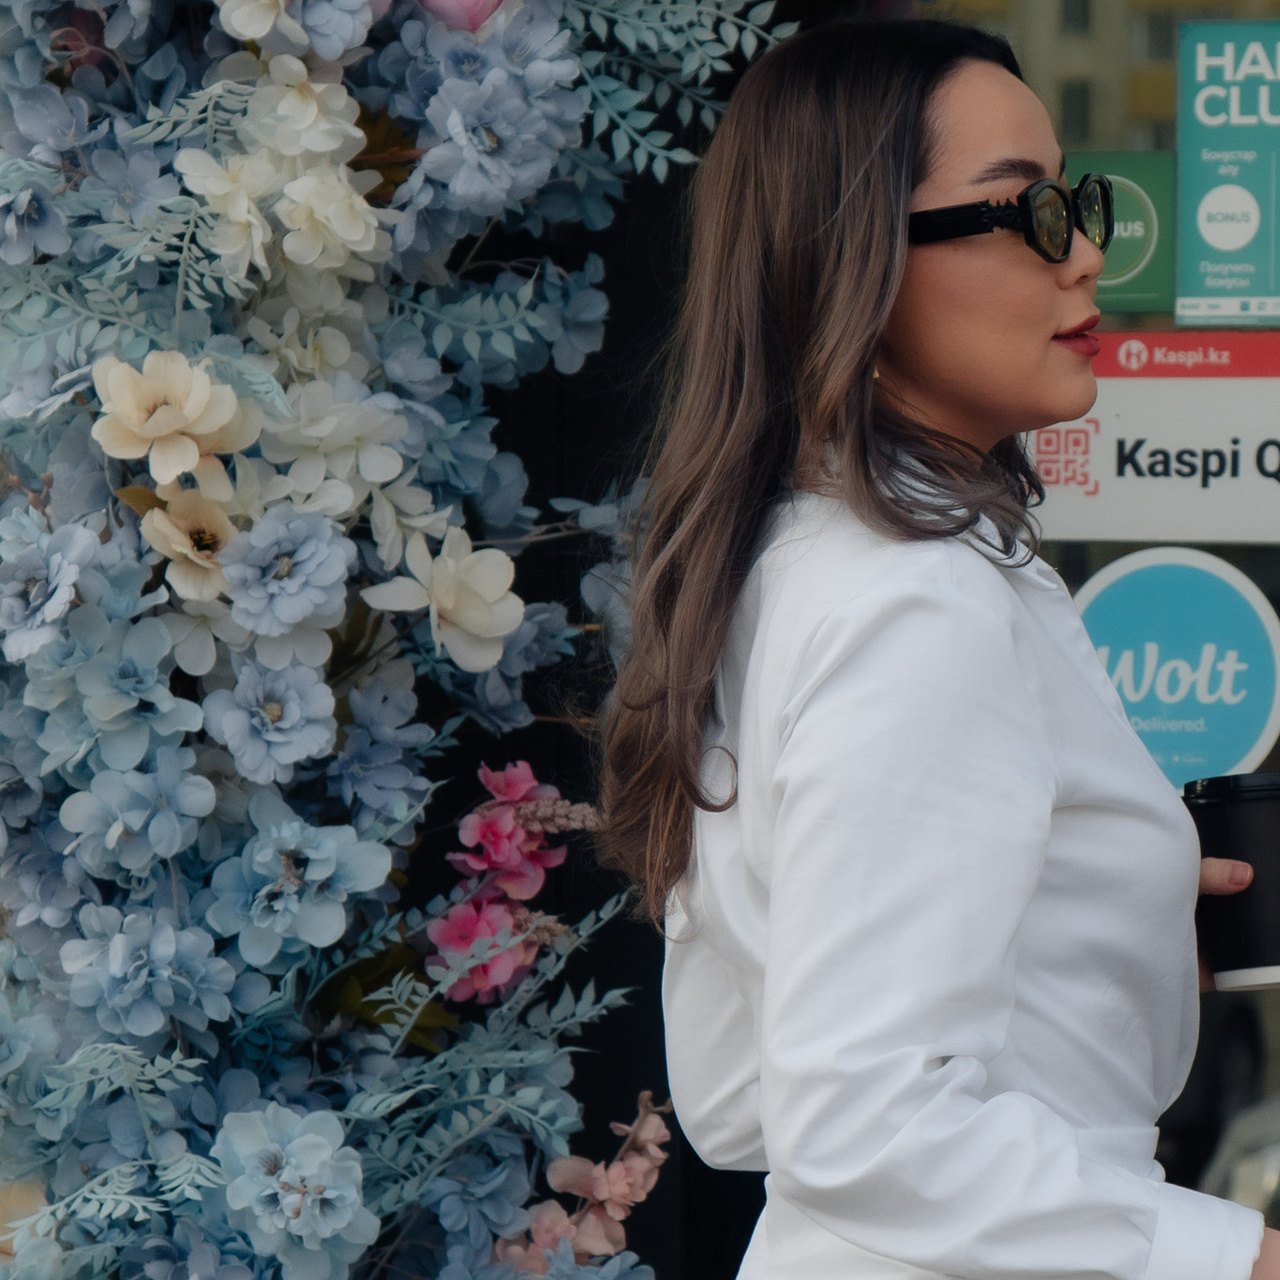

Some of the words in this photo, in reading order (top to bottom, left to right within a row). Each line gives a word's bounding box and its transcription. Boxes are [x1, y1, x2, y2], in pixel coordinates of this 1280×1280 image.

[1206, 211, 1251, 223] BONUS
[1153, 346, 1231, 369] Kaspi.kz
[1115, 437, 1241, 489] Kaspi
[1098, 641, 1249, 705] Wolt
